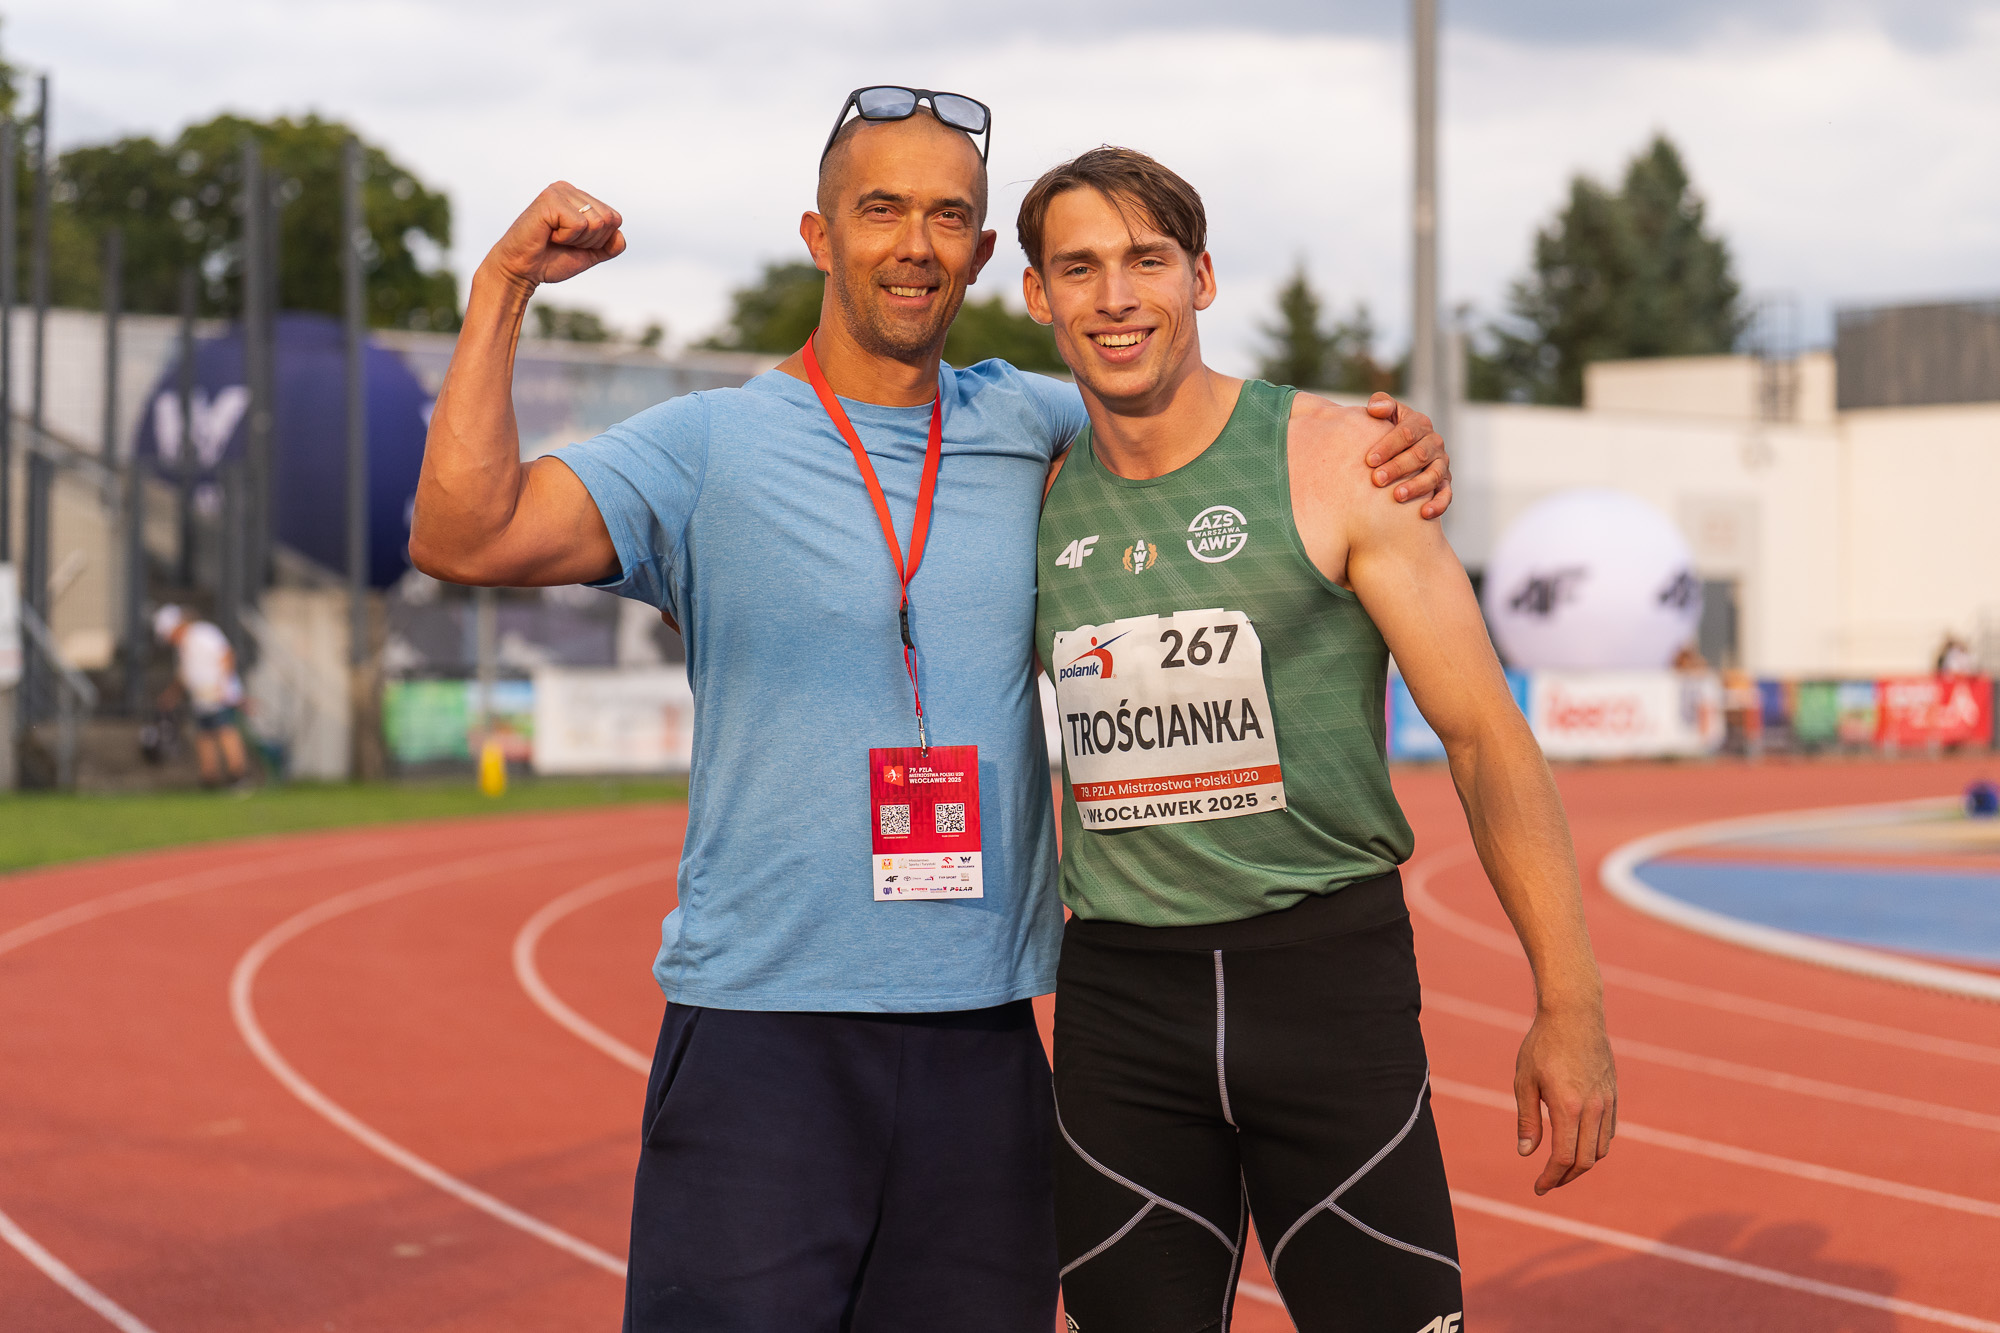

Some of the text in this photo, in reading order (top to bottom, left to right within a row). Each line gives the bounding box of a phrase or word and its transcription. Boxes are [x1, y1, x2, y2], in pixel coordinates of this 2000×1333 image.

[1195, 526, 1241, 538] WARSZAWA
[1200, 513, 1234, 531] AZS
[1055, 535, 1099, 569] 4F
[1197, 534, 1240, 552] AWF
[1159, 624, 1239, 669] 267
[1059, 661, 1100, 683] polanik
[1067, 698, 1264, 757] TROŚCIANKA
[1081, 770, 1259, 798] 79. PZLA Mistrzostwa Polski U20
[1087, 792, 1258, 824] WŁOCŁAWEK 2025
